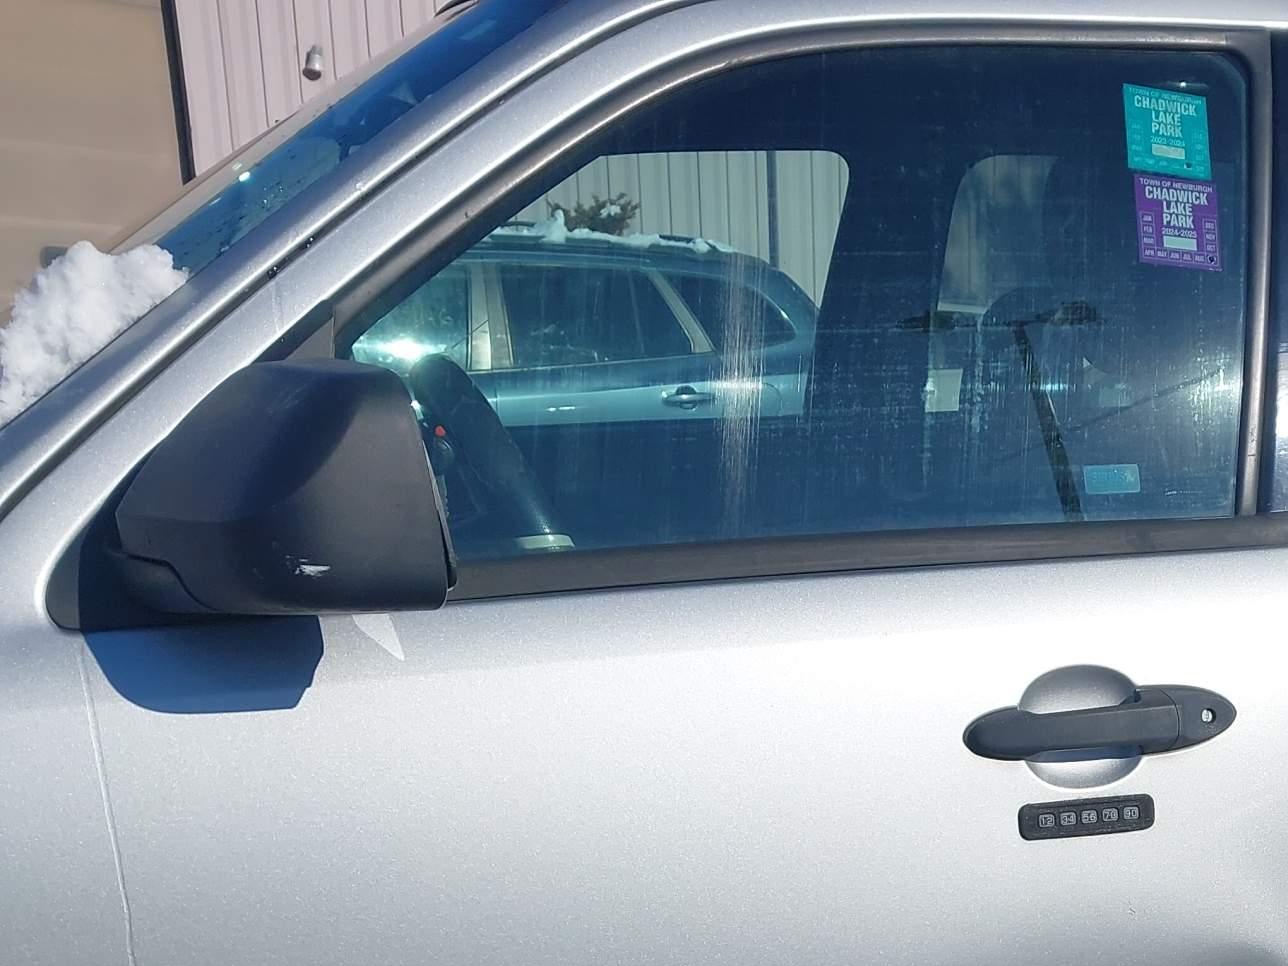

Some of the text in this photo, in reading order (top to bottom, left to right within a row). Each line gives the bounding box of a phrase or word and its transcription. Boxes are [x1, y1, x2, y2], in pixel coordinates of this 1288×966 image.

[1134, 95, 1197, 116] CHADWICK
[1151, 110, 1181, 126] LAKE
[1151, 122, 1183, 138] PARK
[1139, 177, 1213, 193] TOWN OF NEWBURGH
[1145, 185, 1208, 206] CHADWICK
[1163, 200, 1193, 216] LAKE
[1163, 213, 1195, 229] PARK
